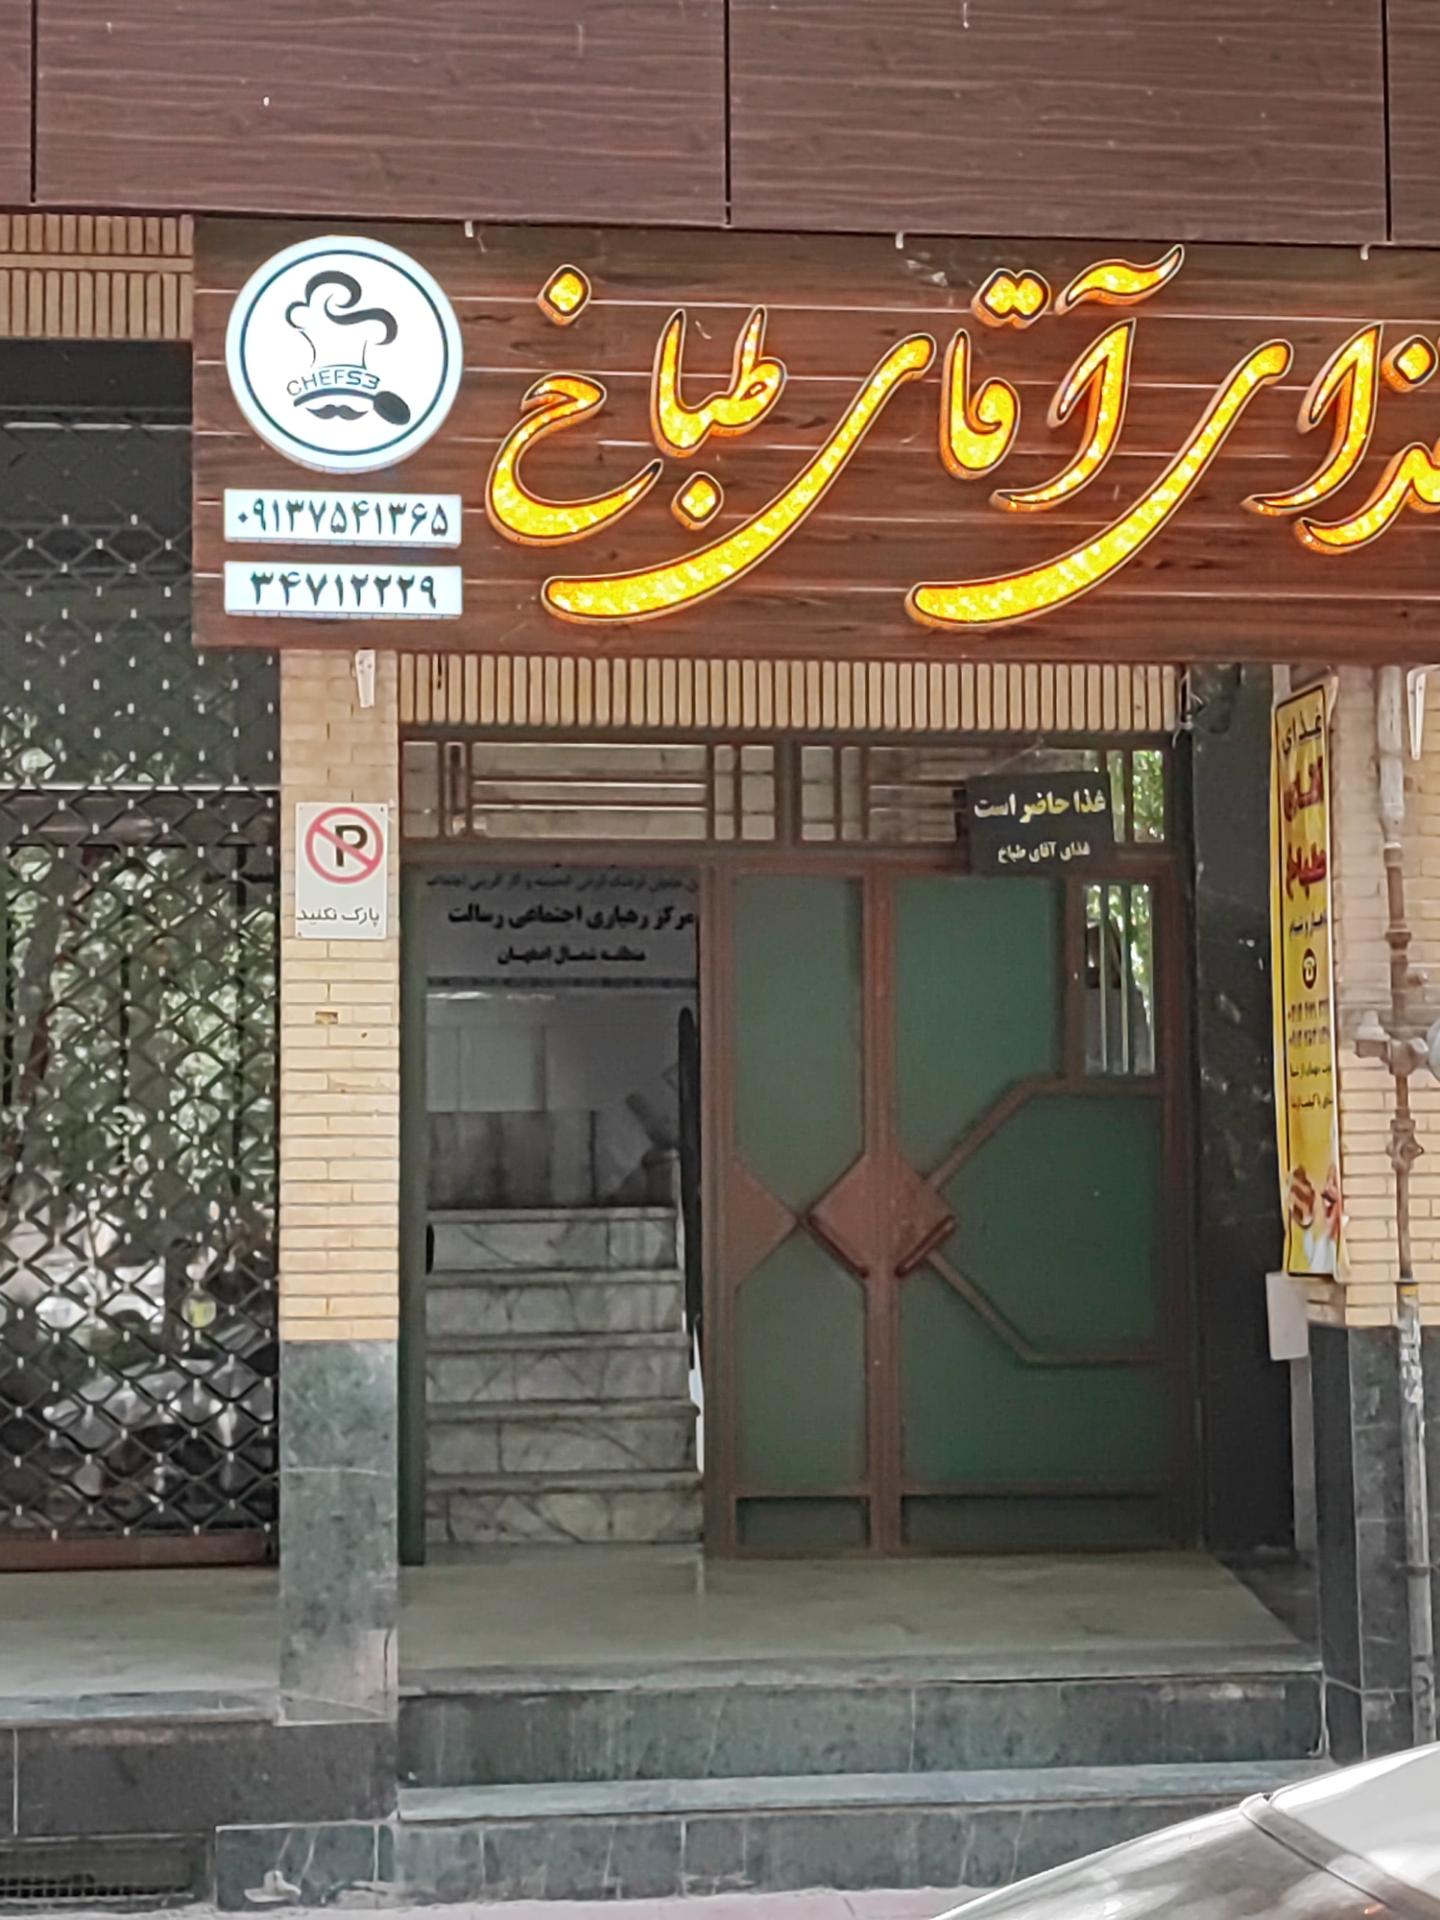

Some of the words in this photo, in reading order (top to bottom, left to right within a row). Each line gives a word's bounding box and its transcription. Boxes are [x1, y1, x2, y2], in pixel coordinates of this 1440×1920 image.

[286, 368, 381, 397] CHEFS3
[484, 262, 790, 548] طباخ
[237, 497, 449, 537] ۰۹۱۳۷۵۴۱۳۶۵
[249, 571, 438, 609] ۳۴۷۱۲۲۲۹
[1282, 706, 1323, 756] غذای
[973, 792, 1017, 818] است
[1018, 790, 1070, 824] حاضر
[1072, 787, 1107, 814] غذا
[334, 824, 368, 867] P
[997, 843, 1027, 864] طباخ
[1028, 840, 1057, 863] آقای
[296, 906, 338, 926] نکنید
[341, 906, 380, 928] پارک
[447, 902, 504, 929] رسالت
[508, 903, 582, 929] اجتماعی
[653, 904, 695, 930] مرکز
